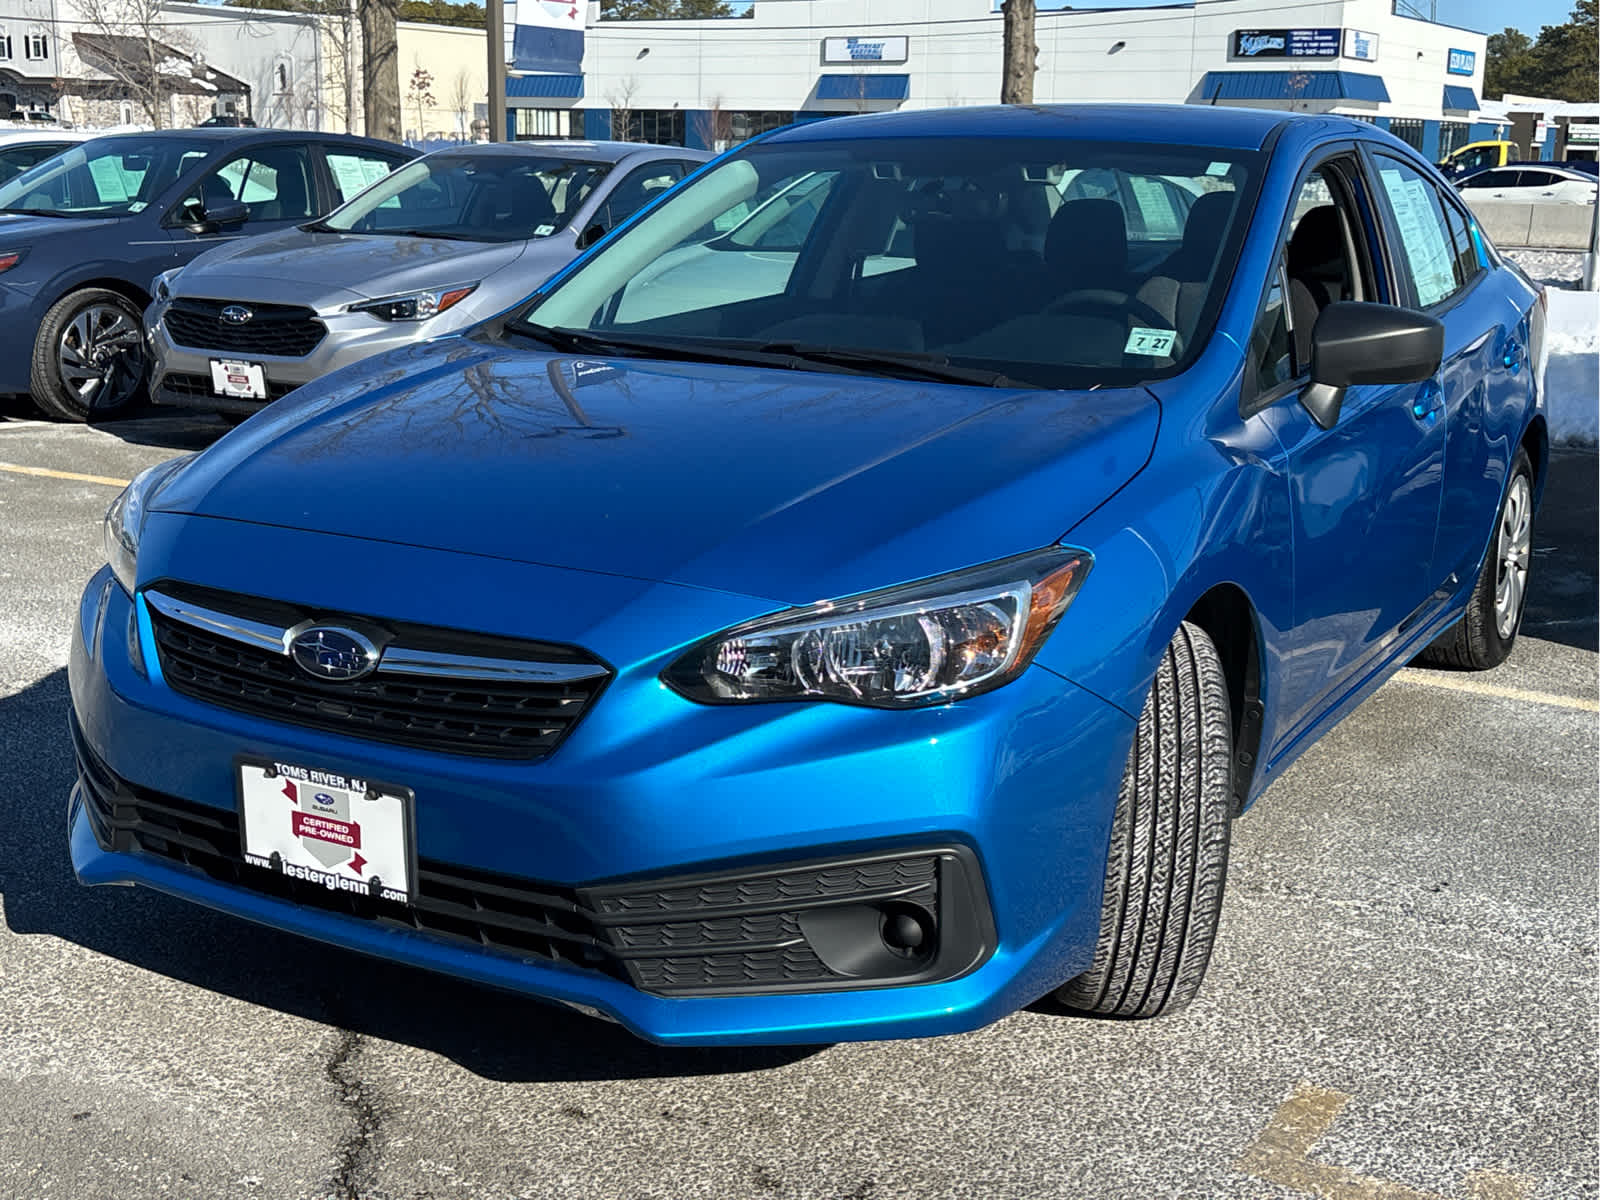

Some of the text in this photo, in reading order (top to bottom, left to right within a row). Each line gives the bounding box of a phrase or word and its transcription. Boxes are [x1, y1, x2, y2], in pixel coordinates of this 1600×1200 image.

[1137, 337, 1170, 349] 7 27
[274, 763, 367, 792] TOMS RIVER, NJ
[299, 824, 354, 844] PRE-OWNED
[303, 816, 349, 834] CERTIFIED
